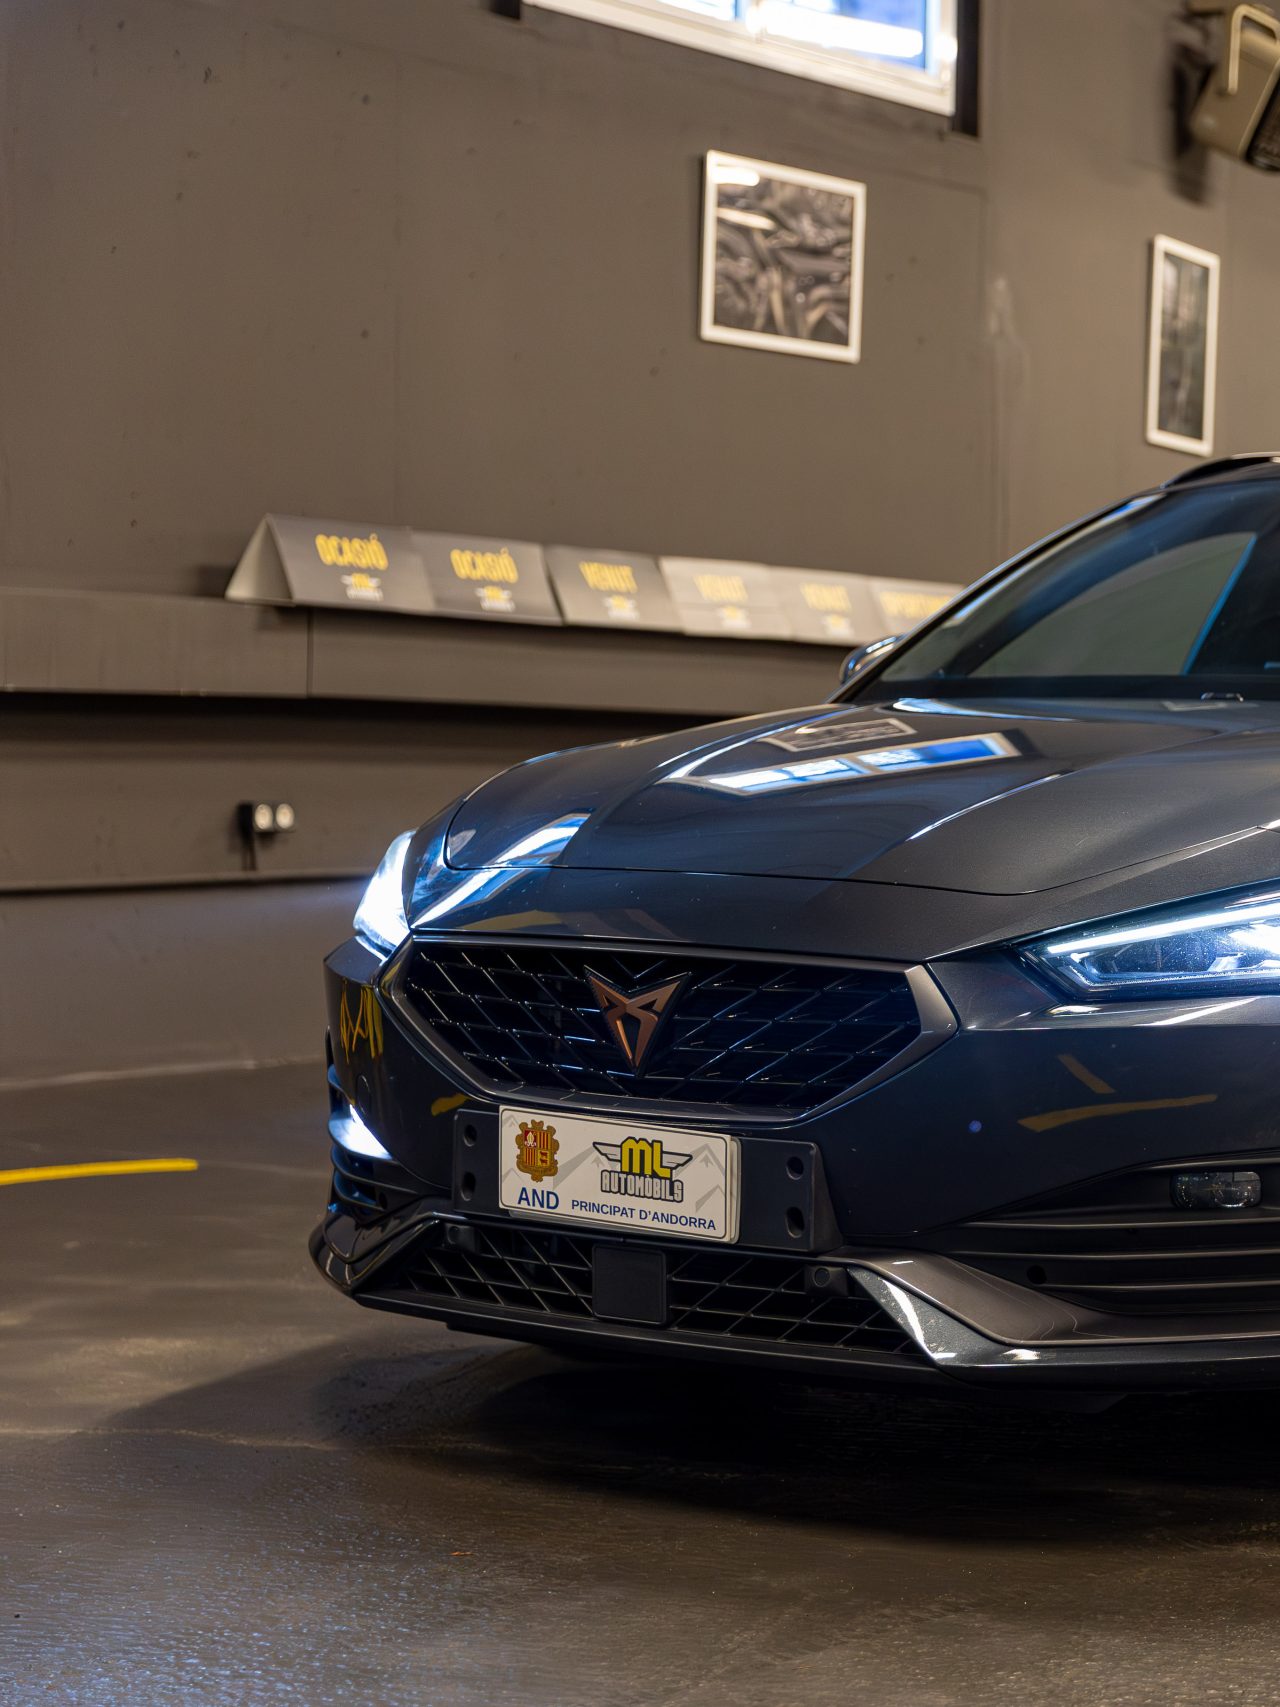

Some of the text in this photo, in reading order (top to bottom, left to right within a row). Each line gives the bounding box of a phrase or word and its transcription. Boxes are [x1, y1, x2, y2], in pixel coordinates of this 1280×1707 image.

[621, 1137, 671, 1178] ML
[517, 1187, 559, 1210] AND
[601, 1171, 684, 1203] AUTOMÒBILS
[571, 1199, 716, 1231] PRINCIPAT D'ANDORRA
